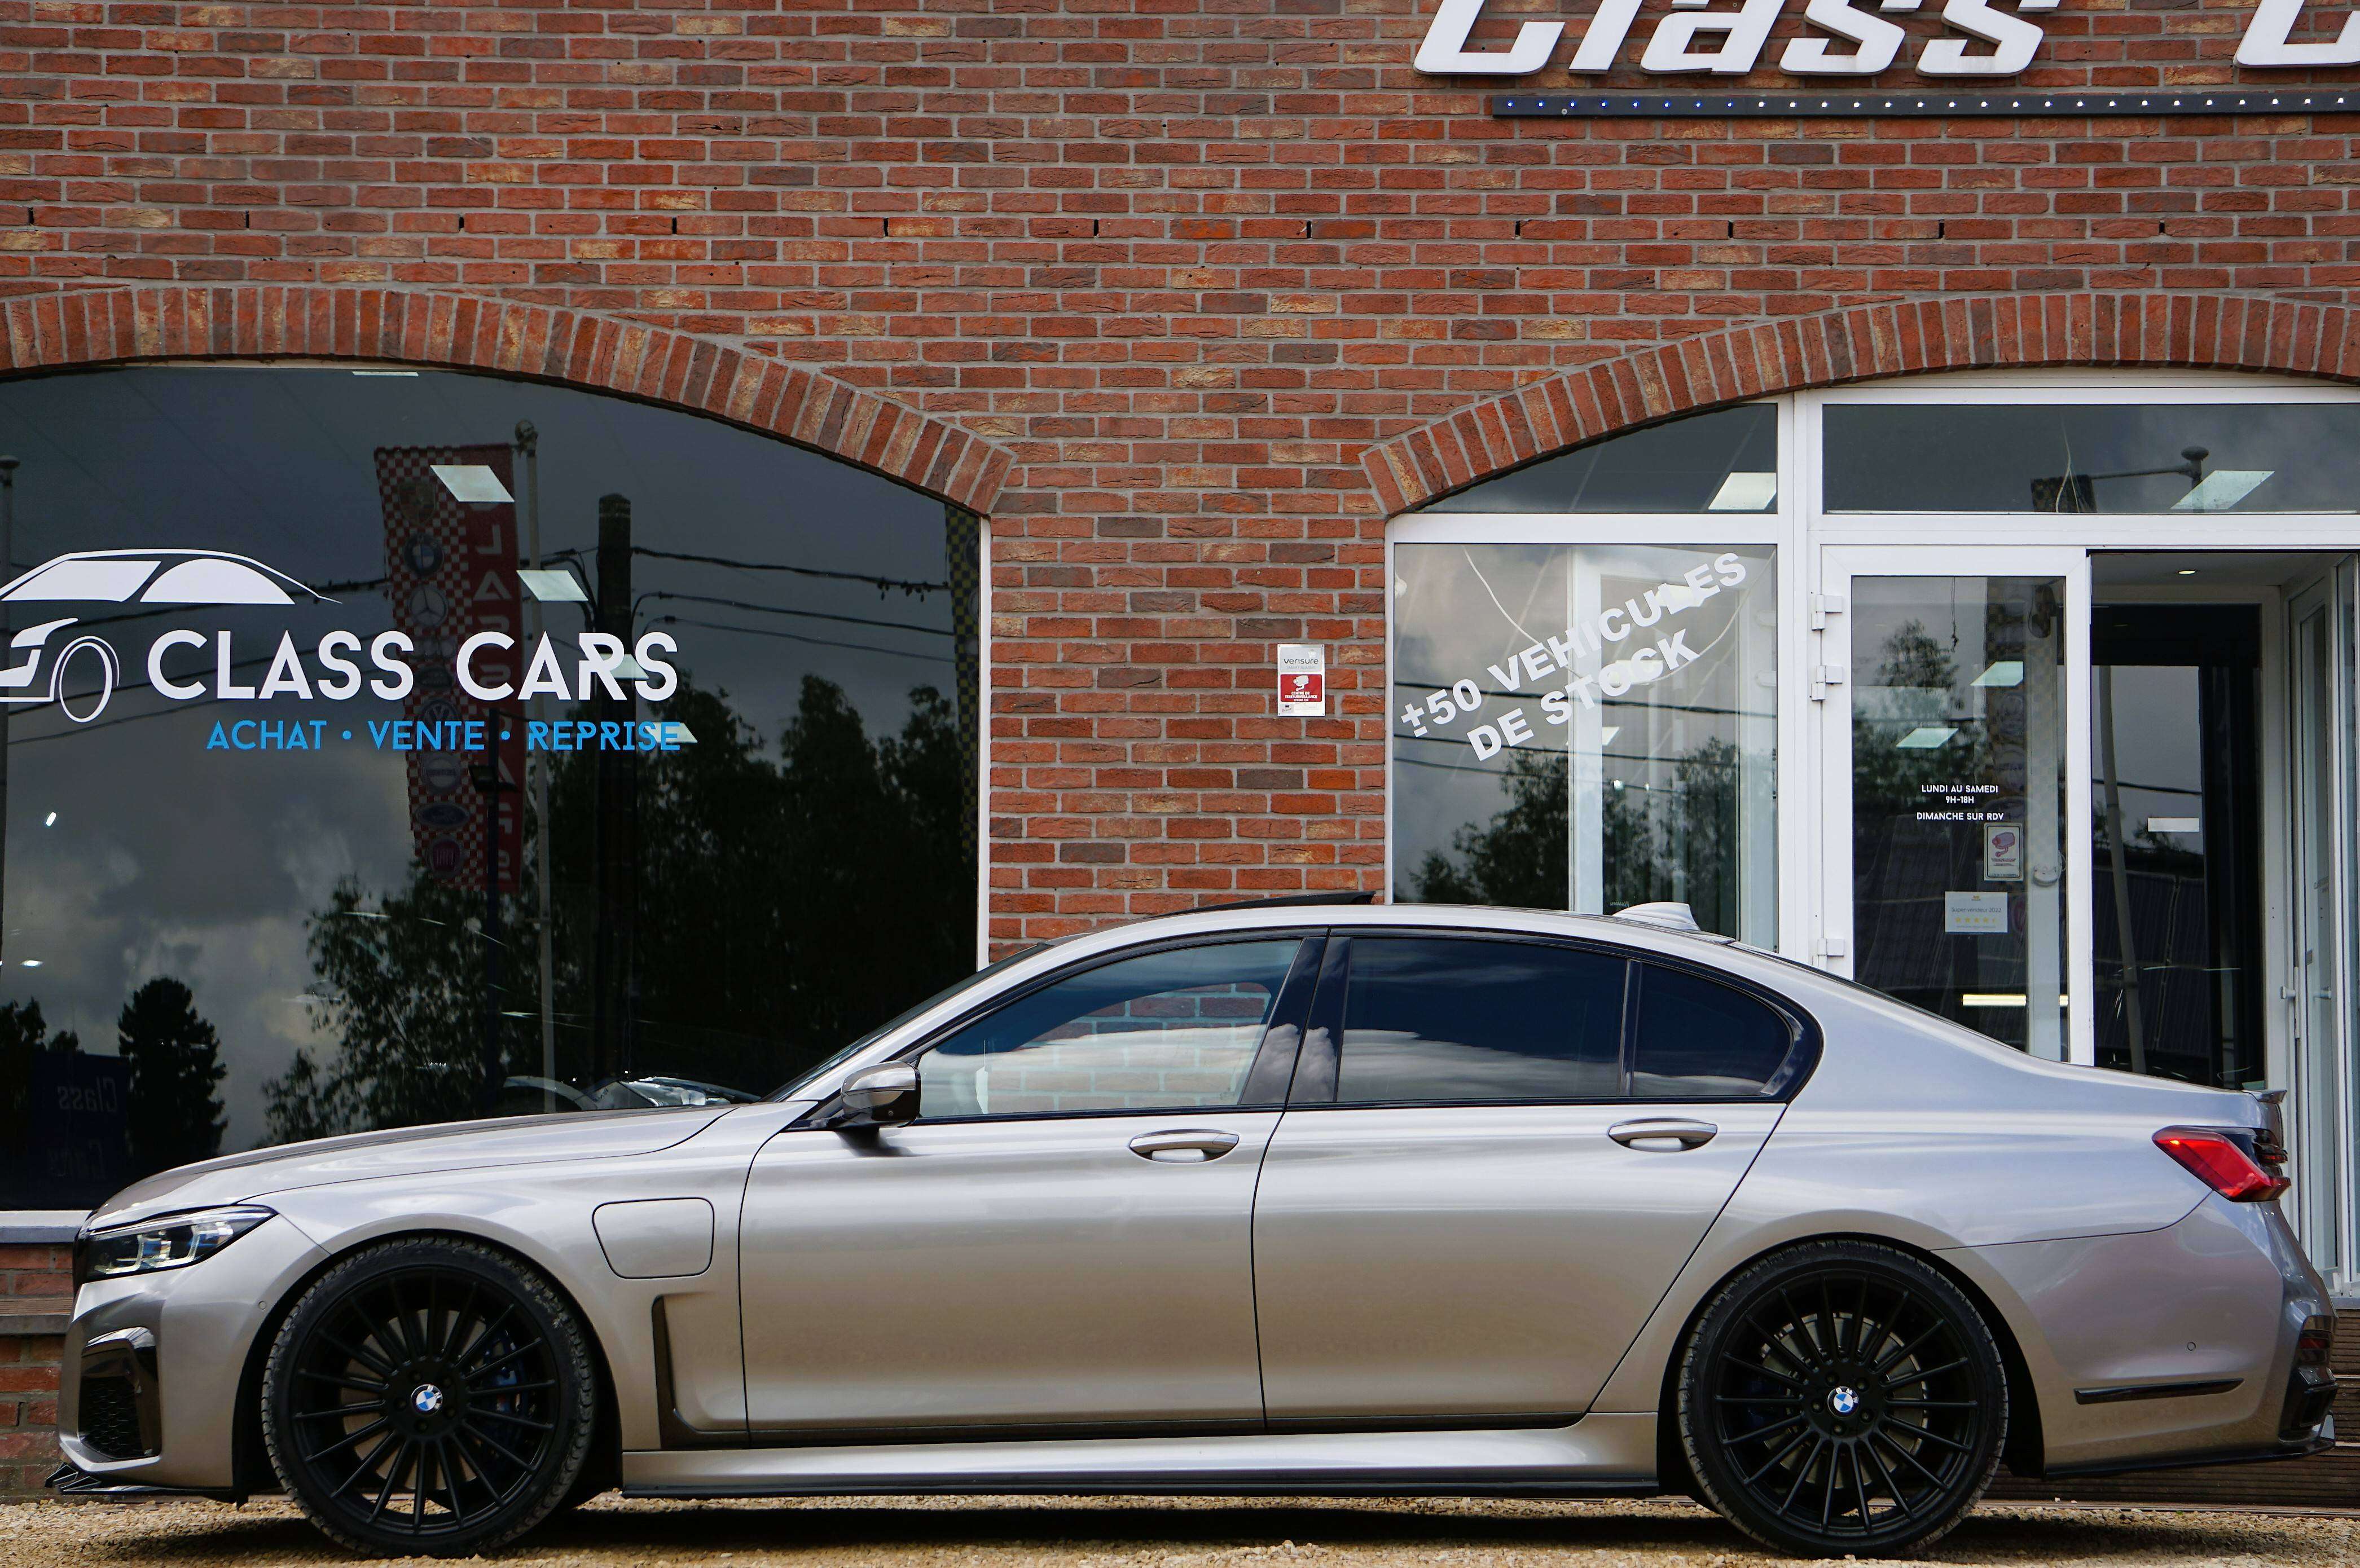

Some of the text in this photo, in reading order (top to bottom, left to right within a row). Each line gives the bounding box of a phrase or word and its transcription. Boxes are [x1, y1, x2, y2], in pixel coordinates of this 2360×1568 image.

[1486, 552, 1747, 692] VEHICULES
[148, 629, 678, 701] CLASS CARS
[1467, 628, 1700, 761] DE STOCK
[206, 720, 680, 751] ACHAT VENTE REPRISE
[1945, 795, 1975, 804] 9H-18H
[1950, 785, 1962, 793] AU
[1965, 785, 1998, 794] SAMEDI
[1917, 812, 2004, 821] DIMANCHE SUR RDV
